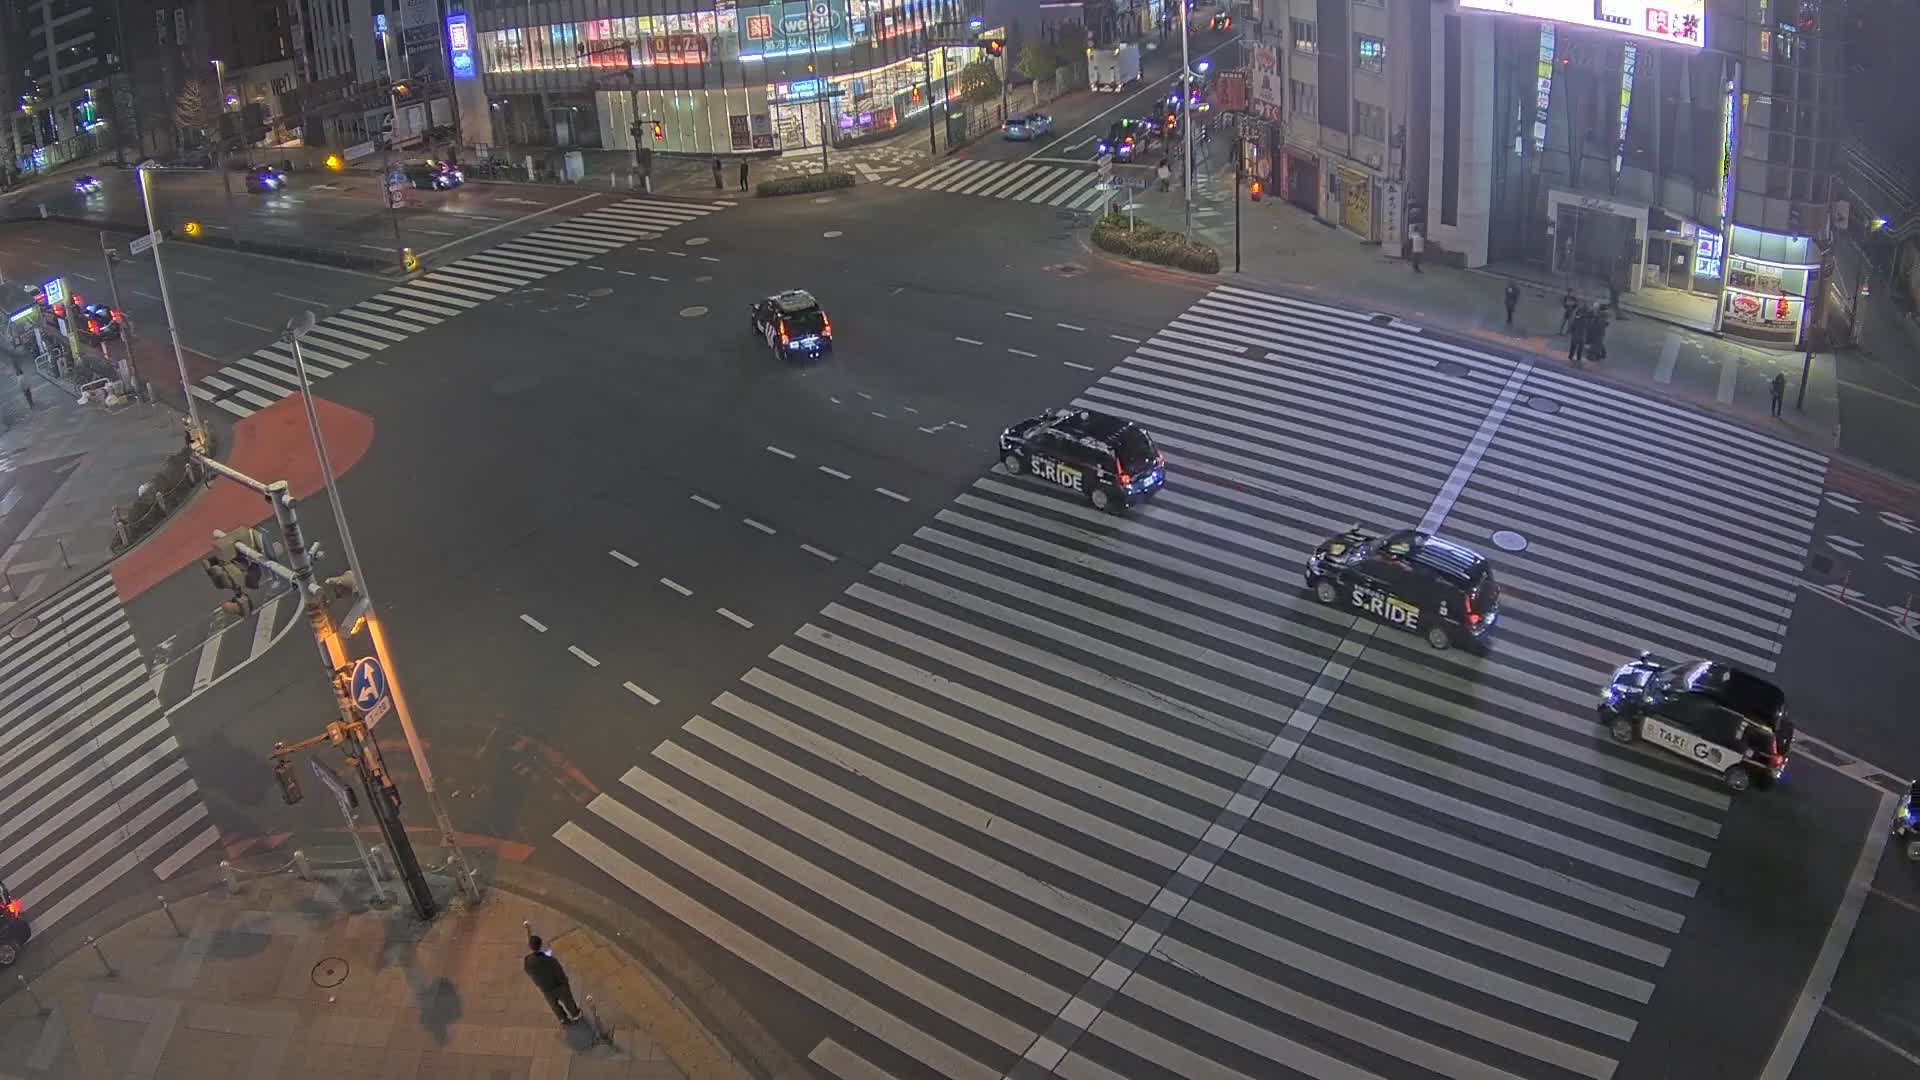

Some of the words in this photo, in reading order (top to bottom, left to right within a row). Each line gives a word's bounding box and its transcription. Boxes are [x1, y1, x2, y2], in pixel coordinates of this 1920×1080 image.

[1031, 460, 1082, 491] S.RIDE
[1352, 590, 1418, 629] S.RIDE
[1660, 728, 1685, 747] TAXI
